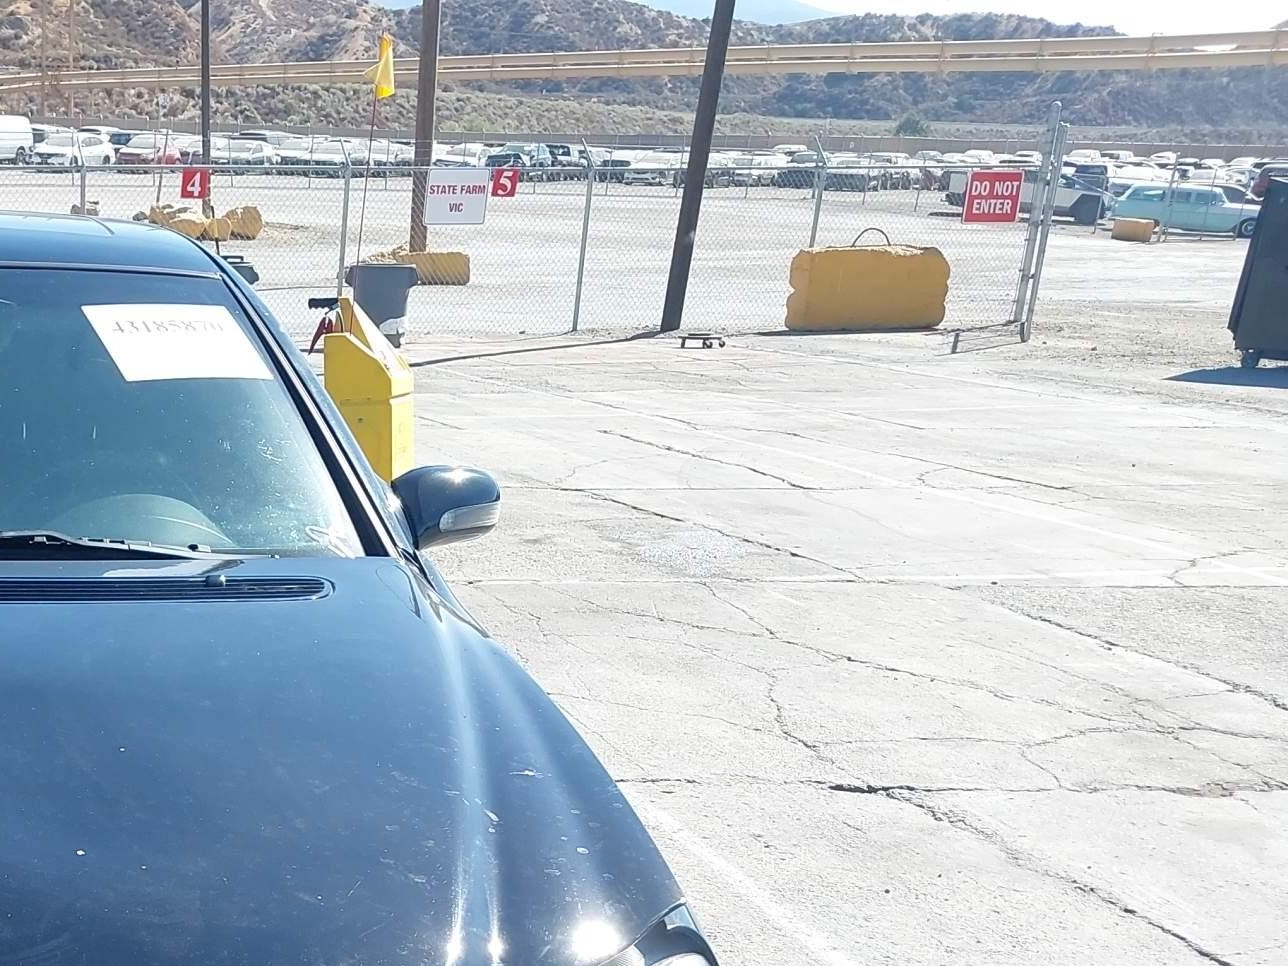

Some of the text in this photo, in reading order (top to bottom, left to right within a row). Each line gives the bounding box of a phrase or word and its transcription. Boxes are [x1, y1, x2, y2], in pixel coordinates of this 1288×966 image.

[186, 171, 202, 197] 4
[429, 184, 486, 195] STATE FARM
[497, 171, 514, 195] 5
[971, 181, 1020, 196] DO NOT
[448, 202, 464, 213] VIC
[972, 199, 1012, 214] ENTER
